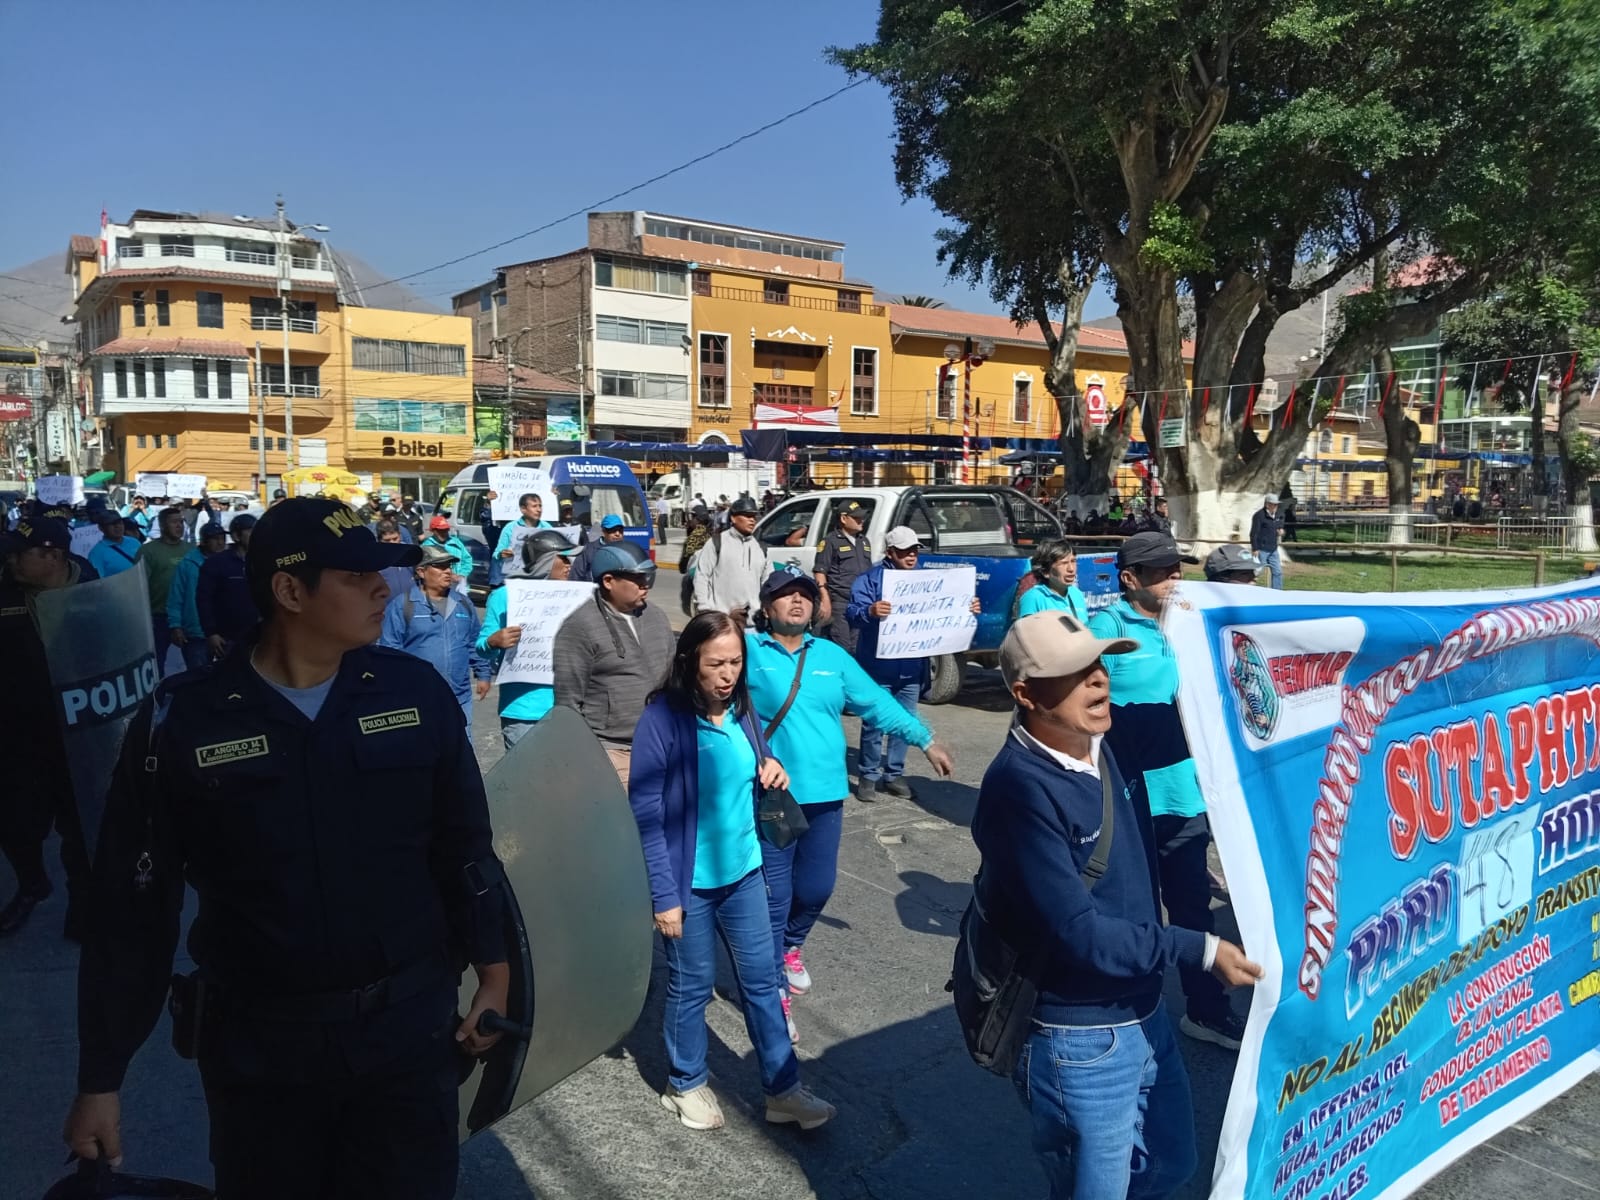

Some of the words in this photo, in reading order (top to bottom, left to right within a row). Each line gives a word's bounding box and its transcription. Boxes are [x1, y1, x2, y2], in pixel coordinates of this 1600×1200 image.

[399, 440, 443, 459] bitel
[566, 461, 621, 475] Huánuco
[275, 550, 308, 568] PERU
[880, 622, 897, 636] LA
[905, 615, 962, 634] MINISTRA
[213, 742, 249, 756] ANGULO
[1277, 1056, 1329, 1114] NO
[1326, 1039, 1364, 1081] AL
[1366, 960, 1443, 1059] REGIMEN
[1534, 866, 1600, 924] TRANSIT
[1448, 990, 1468, 1027] LA
[1464, 932, 1552, 1010] CONSTRUCCIÓN
[1494, 975, 1534, 1018] CANAL
[1420, 1027, 1505, 1103] CONDUCCIÓN
[1504, 1022, 1516, 1046] Y
[1515, 990, 1564, 1038] PLANTA
[1438, 1091, 1461, 1128] DE
[1460, 1035, 1551, 1112] TRATAMIENTO
[1322, 1118, 1344, 1151] LA
[1328, 1101, 1406, 1178] DERECHOS
